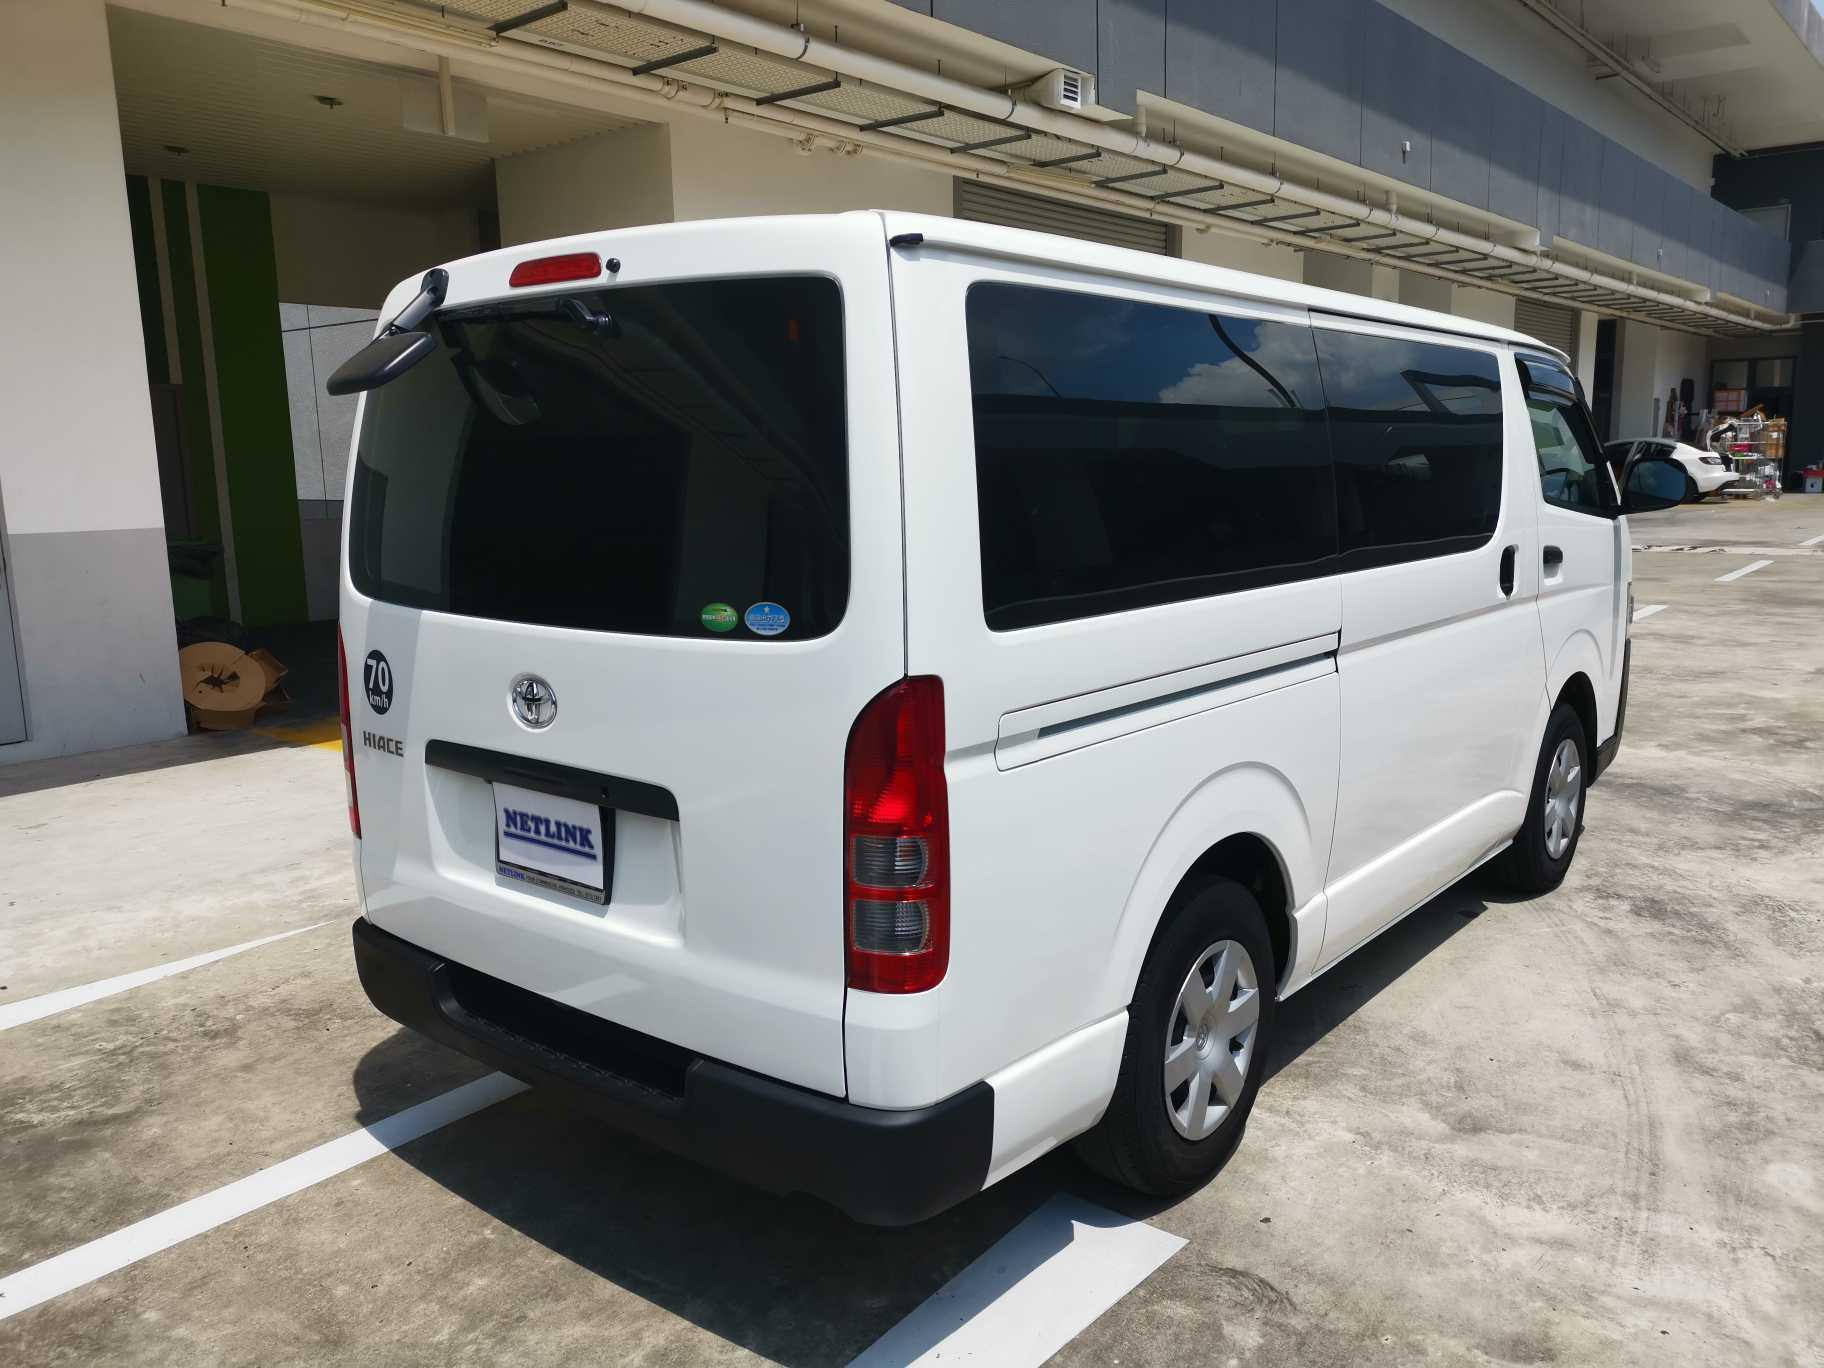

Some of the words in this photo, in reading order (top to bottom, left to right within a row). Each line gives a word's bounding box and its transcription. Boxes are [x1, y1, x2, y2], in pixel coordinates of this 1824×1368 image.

[367, 659, 389, 693] 70
[369, 691, 389, 708] km/h
[363, 731, 404, 757] HIACE
[503, 808, 594, 850] NETLINK
[499, 865, 525, 881] NETLINK
